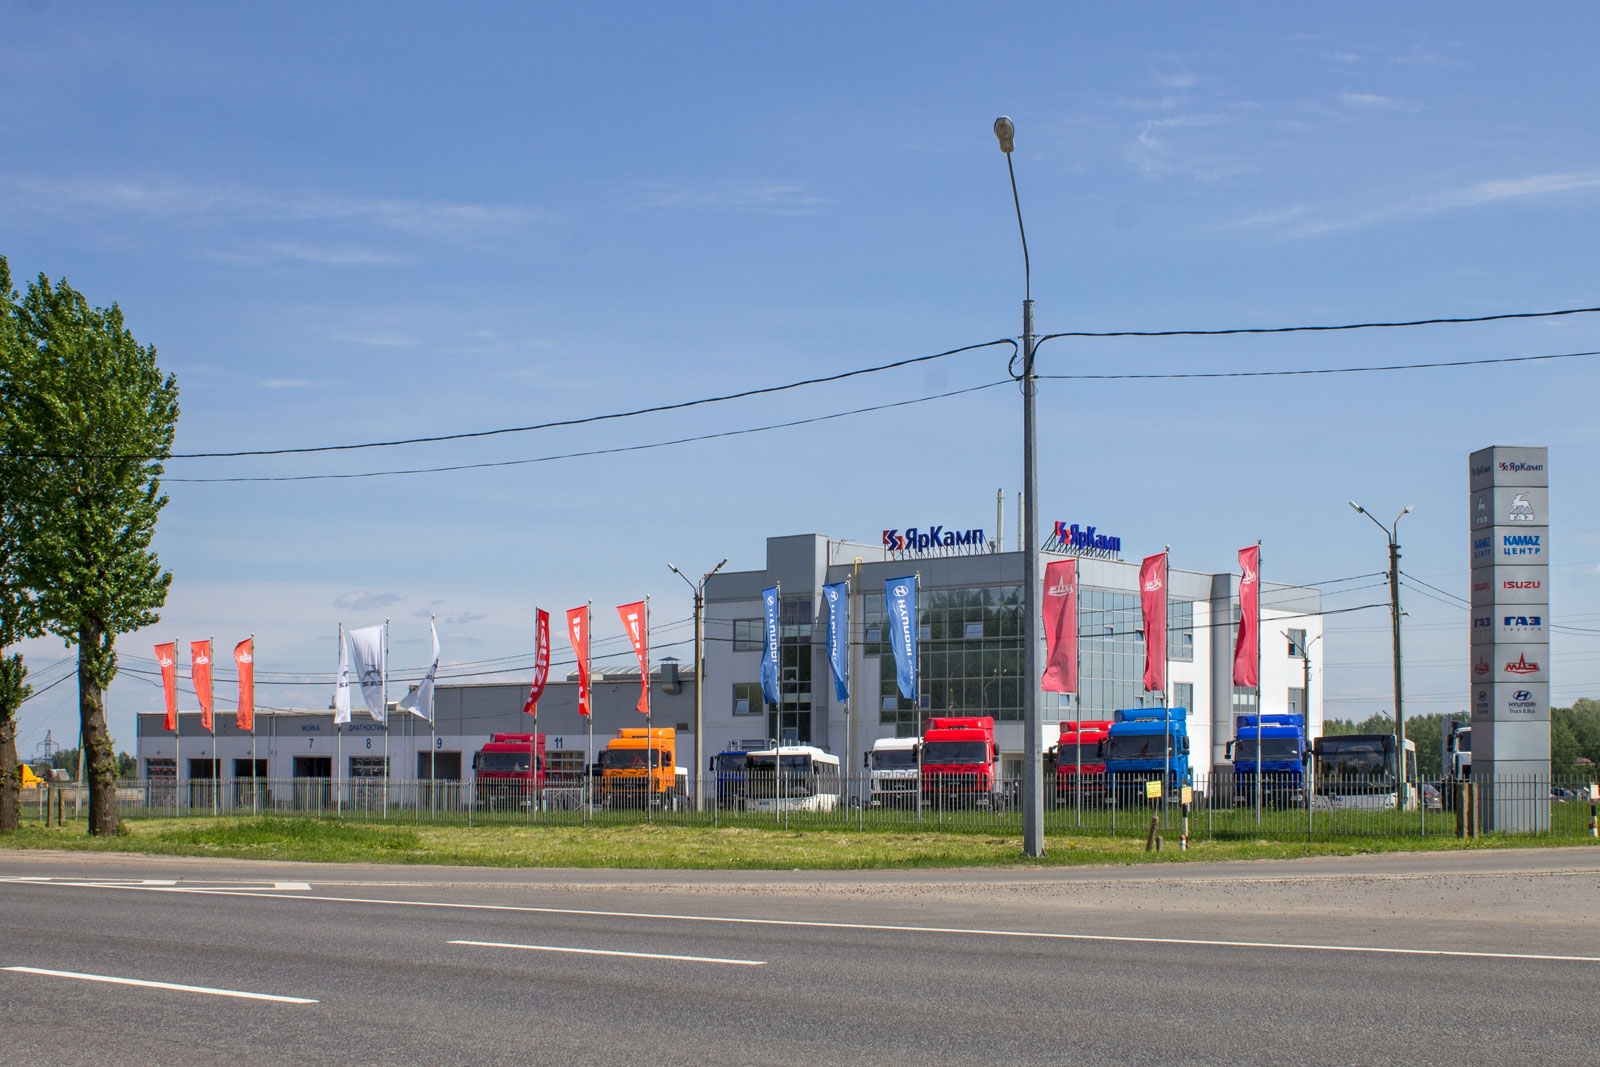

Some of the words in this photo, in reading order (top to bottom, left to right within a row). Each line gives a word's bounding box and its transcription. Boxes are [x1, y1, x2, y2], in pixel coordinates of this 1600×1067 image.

[1508, 462, 1544, 472] ЯрКамп
[904, 525, 984, 552] ЯрКамп
[1069, 523, 1121, 552] ЯрКамп
[1503, 535, 1541, 546] KAMAZ
[1503, 547, 1541, 556] ЦЕНТР
[1503, 581, 1541, 589] ISUZU
[1503, 616, 1542, 626] ГАЗ
[308, 738, 314, 749] 7
[366, 738, 372, 749] 8
[436, 738, 443, 749] 9
[554, 737, 563, 749] 11
